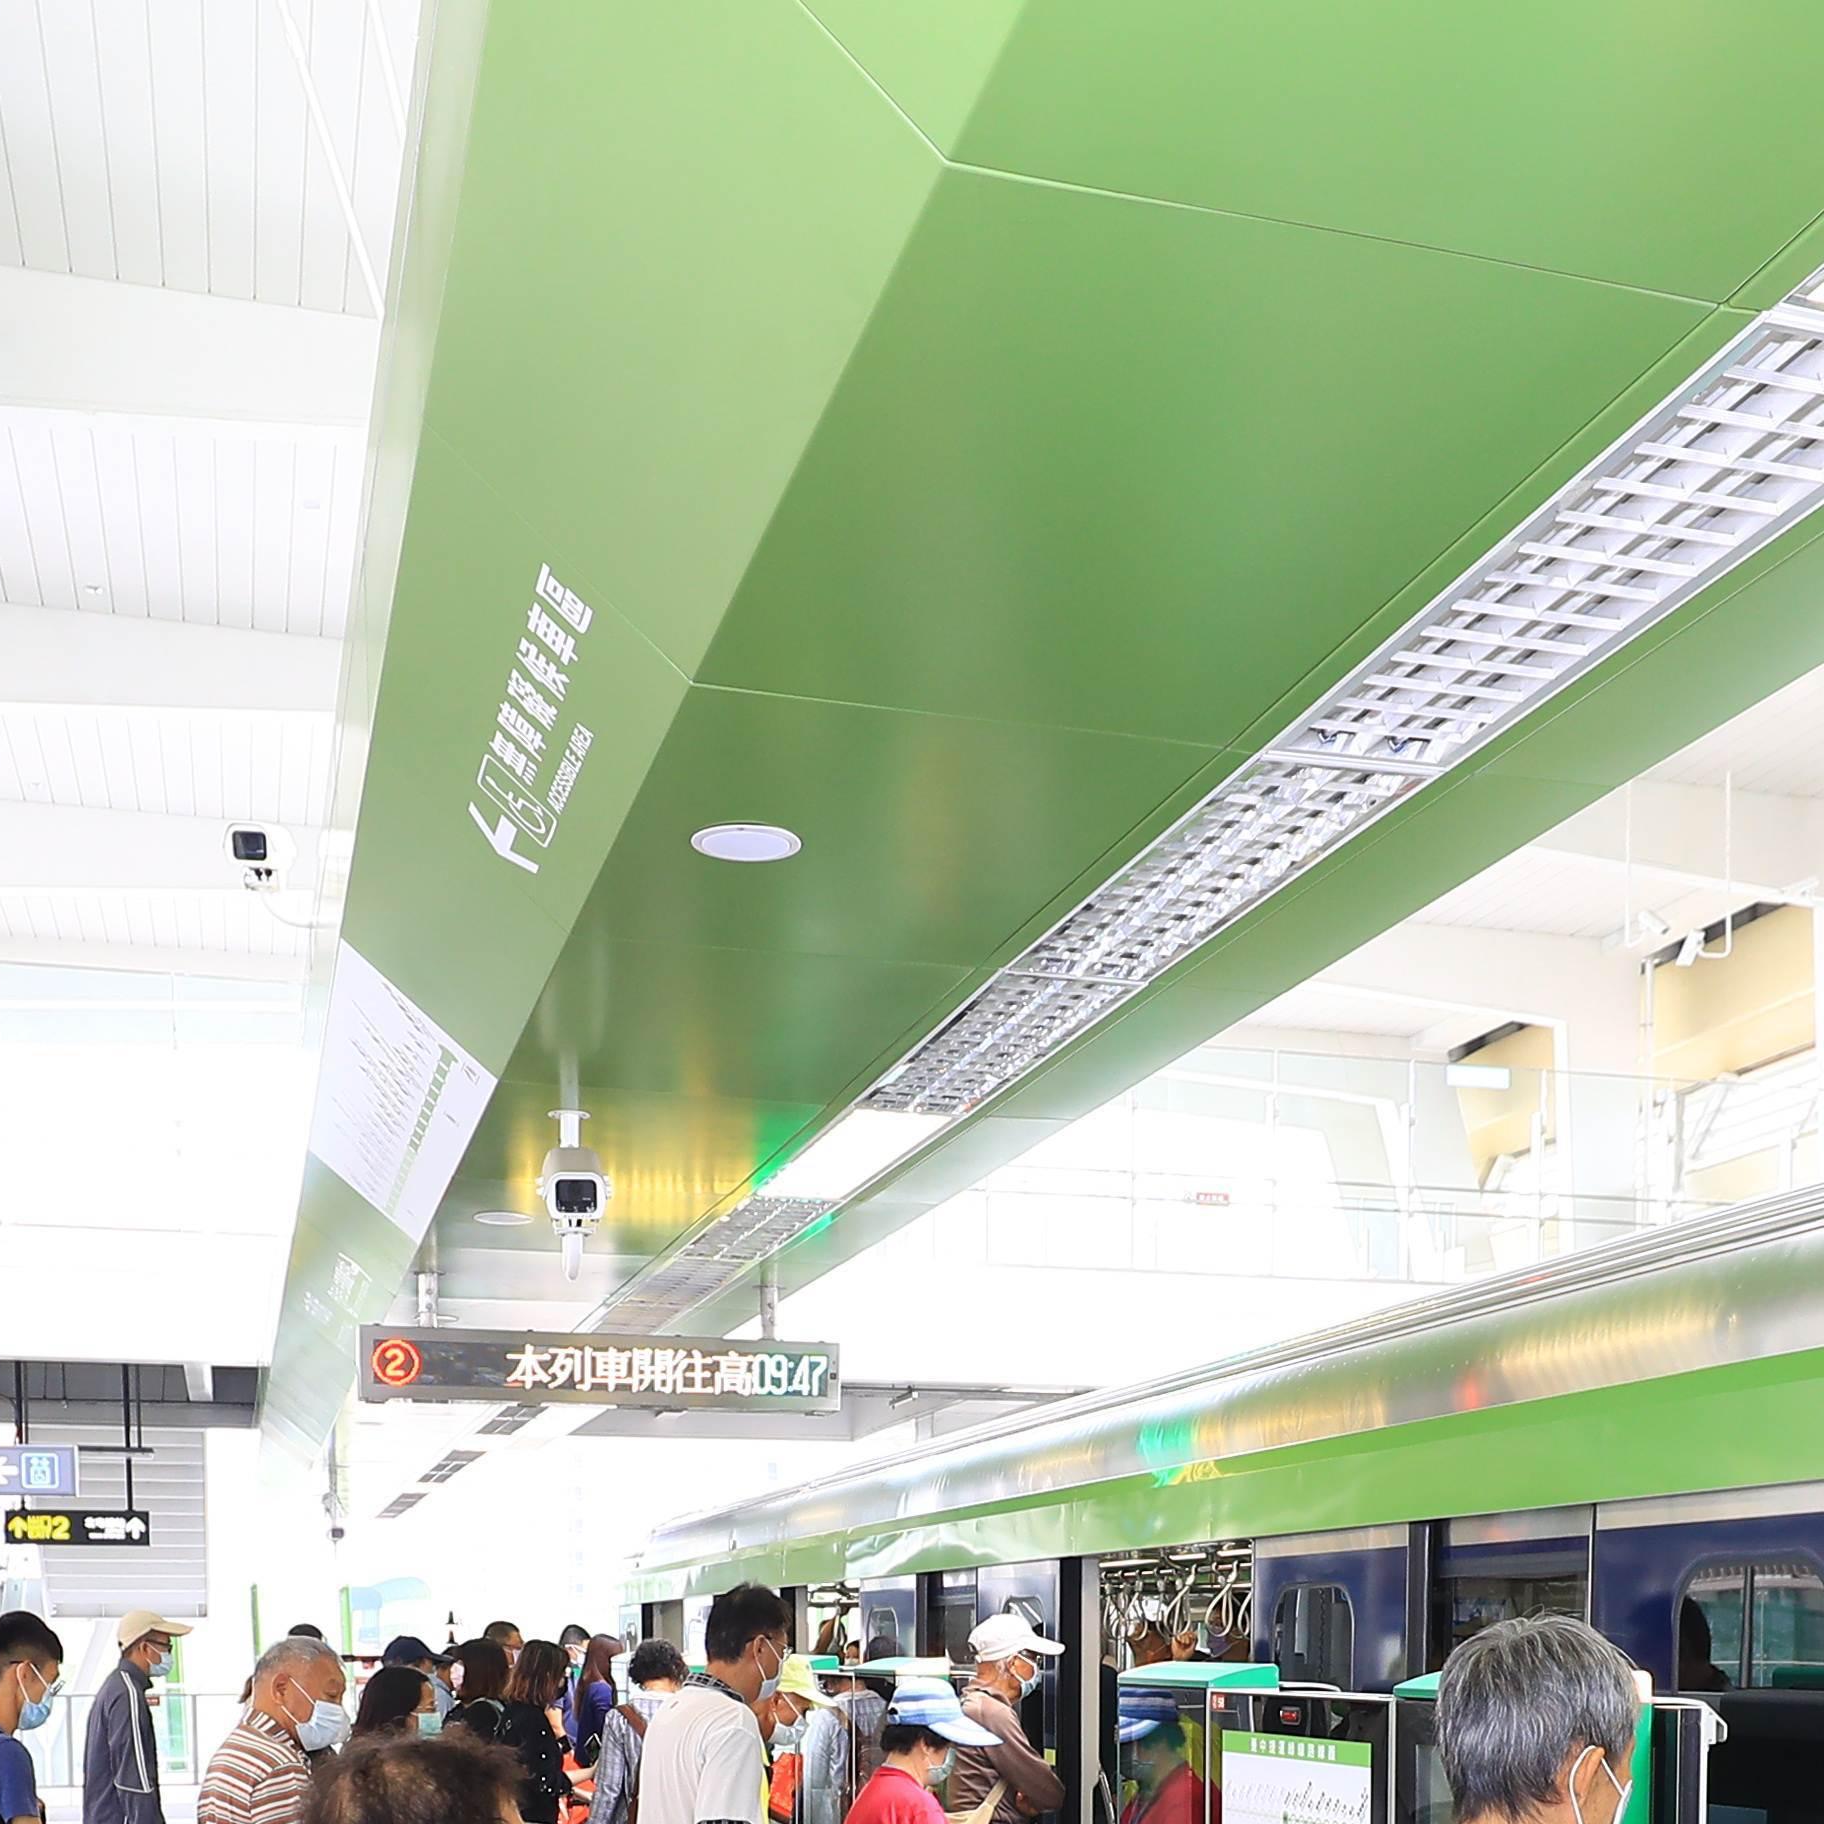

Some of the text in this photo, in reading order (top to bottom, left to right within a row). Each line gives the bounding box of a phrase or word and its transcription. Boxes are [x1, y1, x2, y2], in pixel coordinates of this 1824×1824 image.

[489, 562, 594, 787] 無障礙候車區
[547, 722, 594, 815] ACCESSIBLE AREA
[506, 1343, 828, 1397] 本列車開往高 09:47
[52, 1515, 71, 1540] 2
